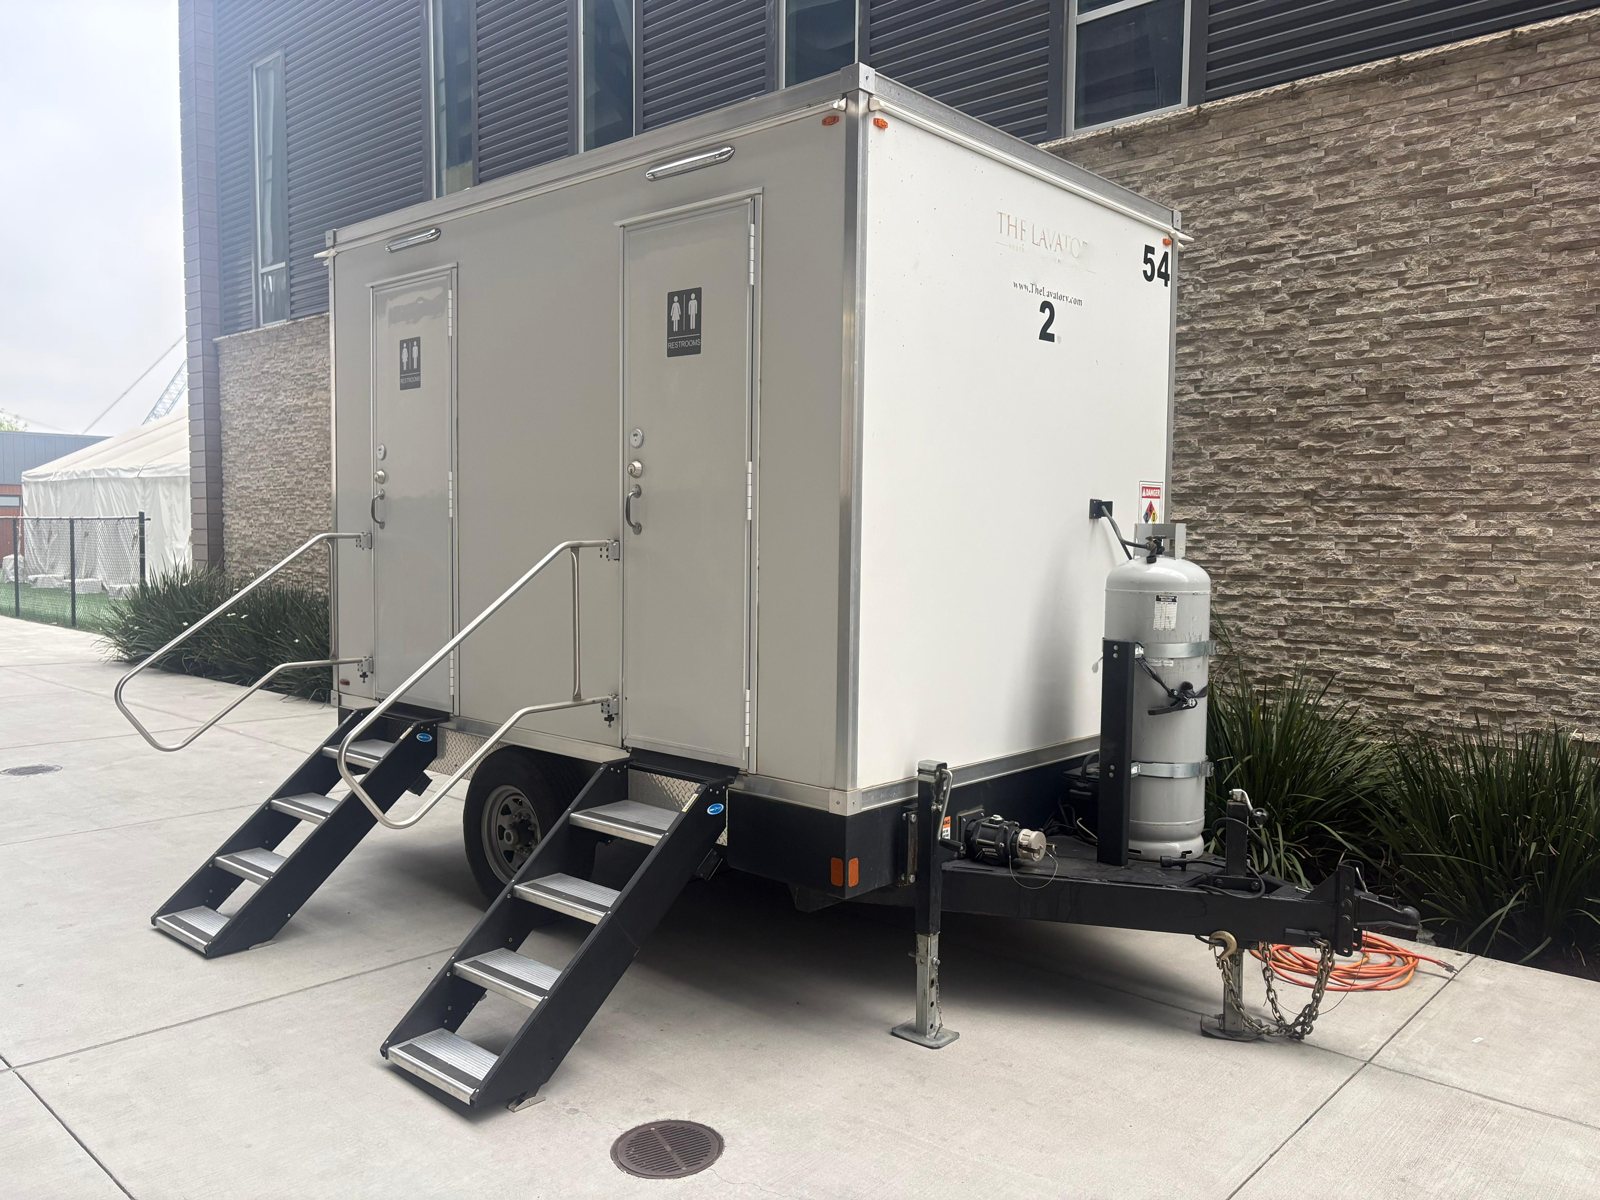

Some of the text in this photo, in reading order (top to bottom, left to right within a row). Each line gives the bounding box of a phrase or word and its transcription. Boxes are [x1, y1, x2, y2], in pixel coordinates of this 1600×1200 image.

[996, 211, 1089, 259] THE LAVATO
[1142, 244, 1170, 288] 54
[1038, 300, 1055, 343] 2
[668, 339, 701, 349] RESTROOMS
[400, 375, 420, 384] RESTROO
[1145, 488, 1161, 497] DANGER
